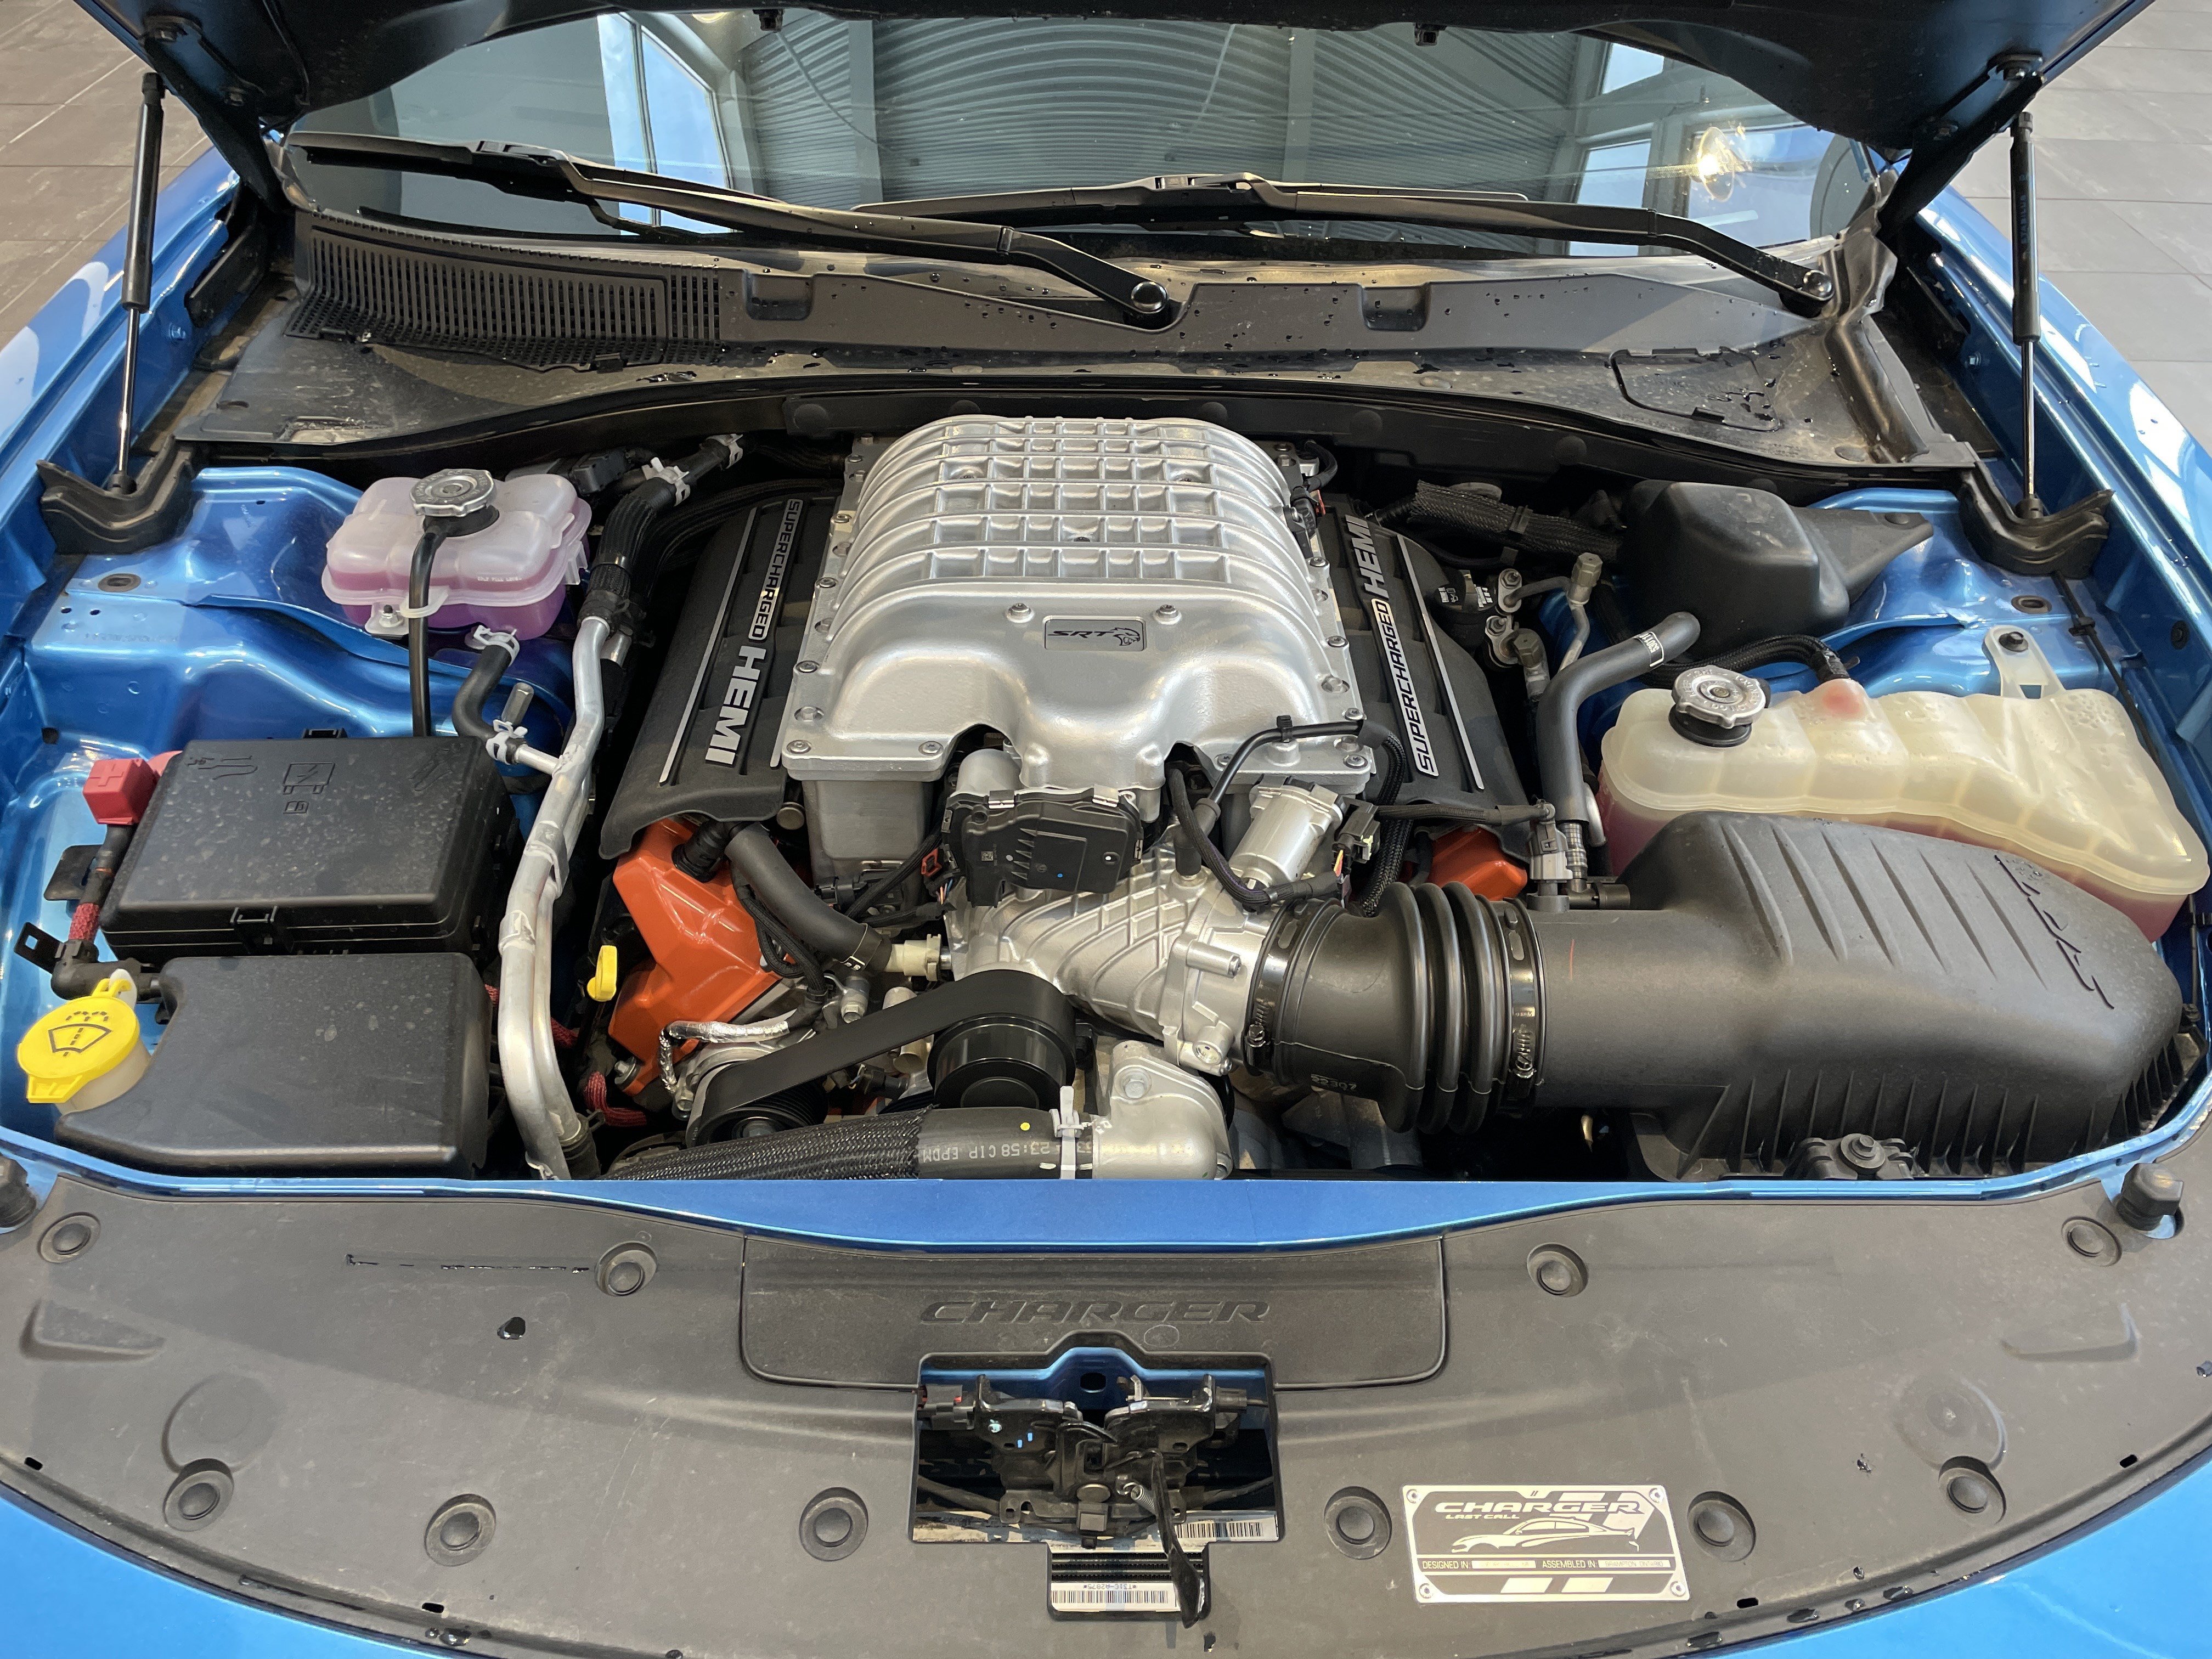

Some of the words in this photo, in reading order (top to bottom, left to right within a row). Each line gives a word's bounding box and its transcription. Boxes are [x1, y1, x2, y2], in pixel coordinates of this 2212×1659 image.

[1345, 515, 1390, 599] HEMI
[751, 500, 802, 639] SUPERCHARGED
[1374, 602, 1435, 773] SUPERCHARGED
[705, 646, 766, 766] HEMI
[923, 1146, 959, 1163] EPDM
[969, 1144, 996, 1159] CIP
[1001, 1141, 1050, 1157] 23:58
[919, 1301, 1270, 1324] CHARGER
[1435, 1502, 1645, 1515] CHARGER
[1422, 1560, 1459, 1570] DESIGNED
[1542, 1560, 1585, 1568] ASSEMBLED
